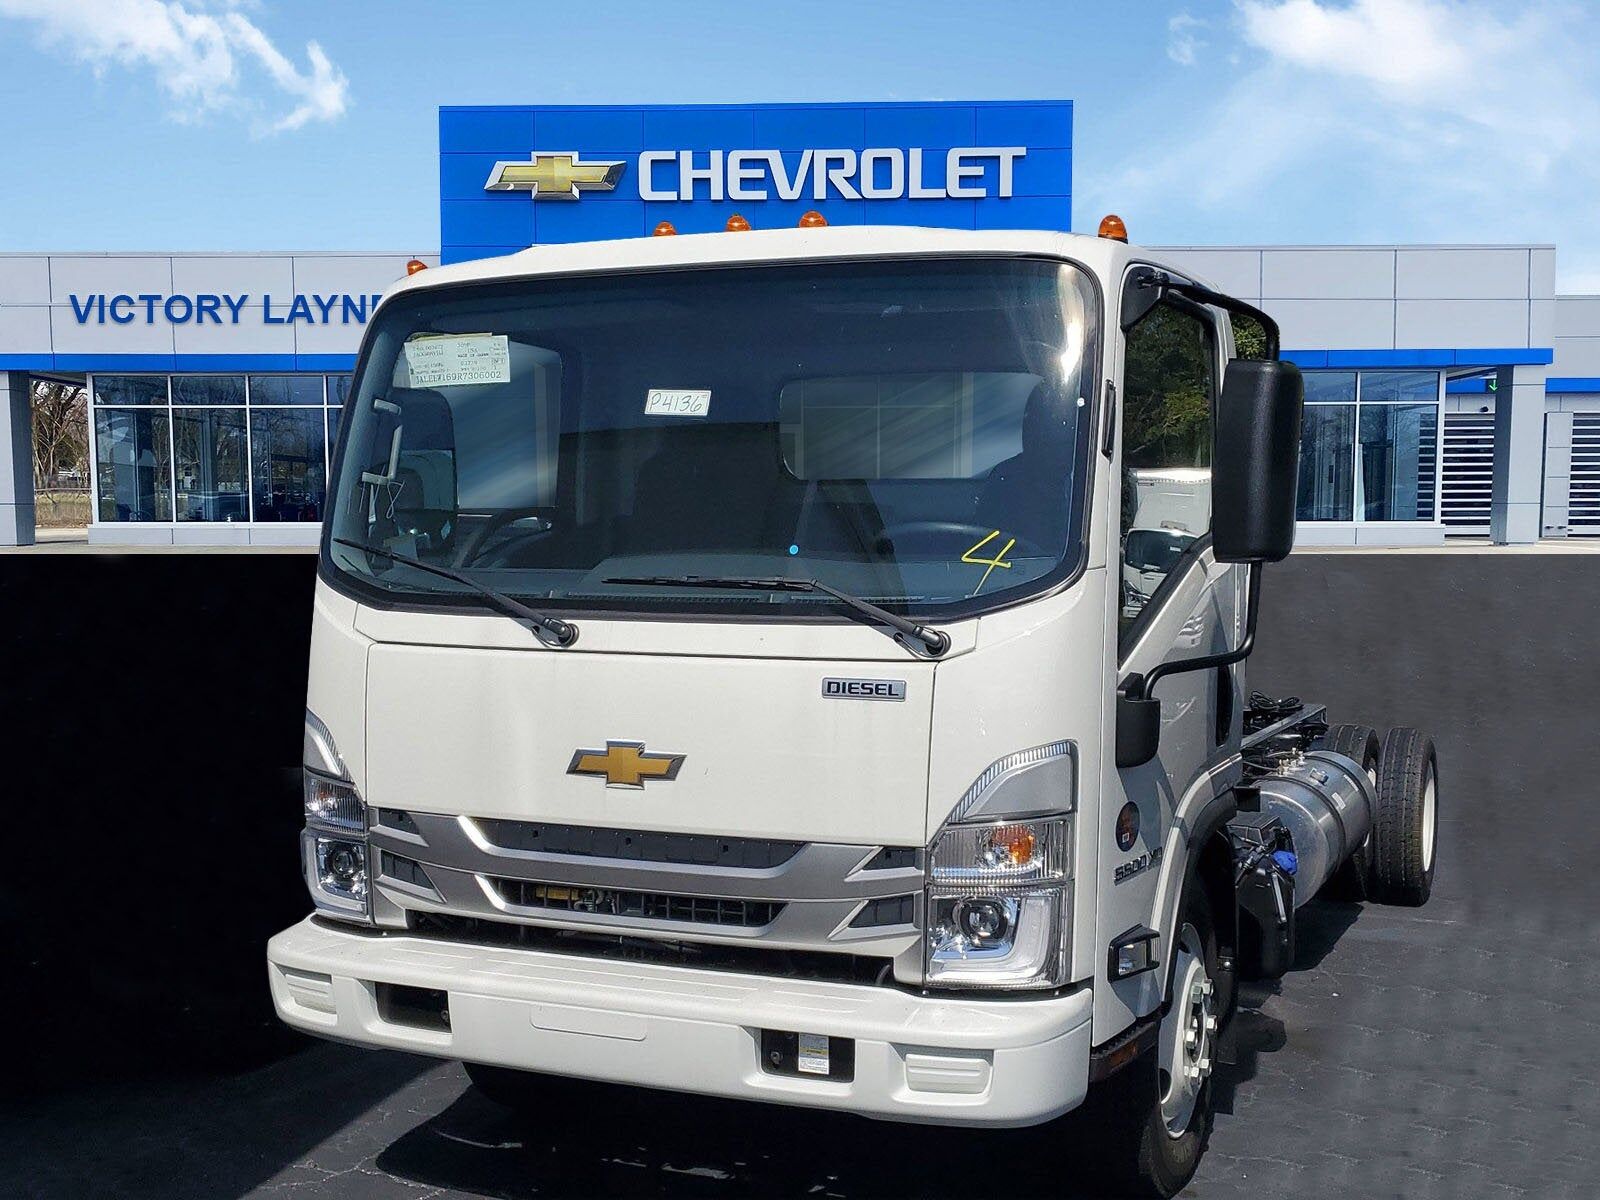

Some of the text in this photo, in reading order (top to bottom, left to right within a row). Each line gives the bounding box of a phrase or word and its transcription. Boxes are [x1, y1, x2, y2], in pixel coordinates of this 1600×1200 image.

[638, 147, 1027, 201] CHEVROLET
[69, 294, 248, 324] VICTORY
[650, 392, 702, 412] P4136
[961, 530, 1015, 596] 4
[827, 681, 899, 696] DIESEL
